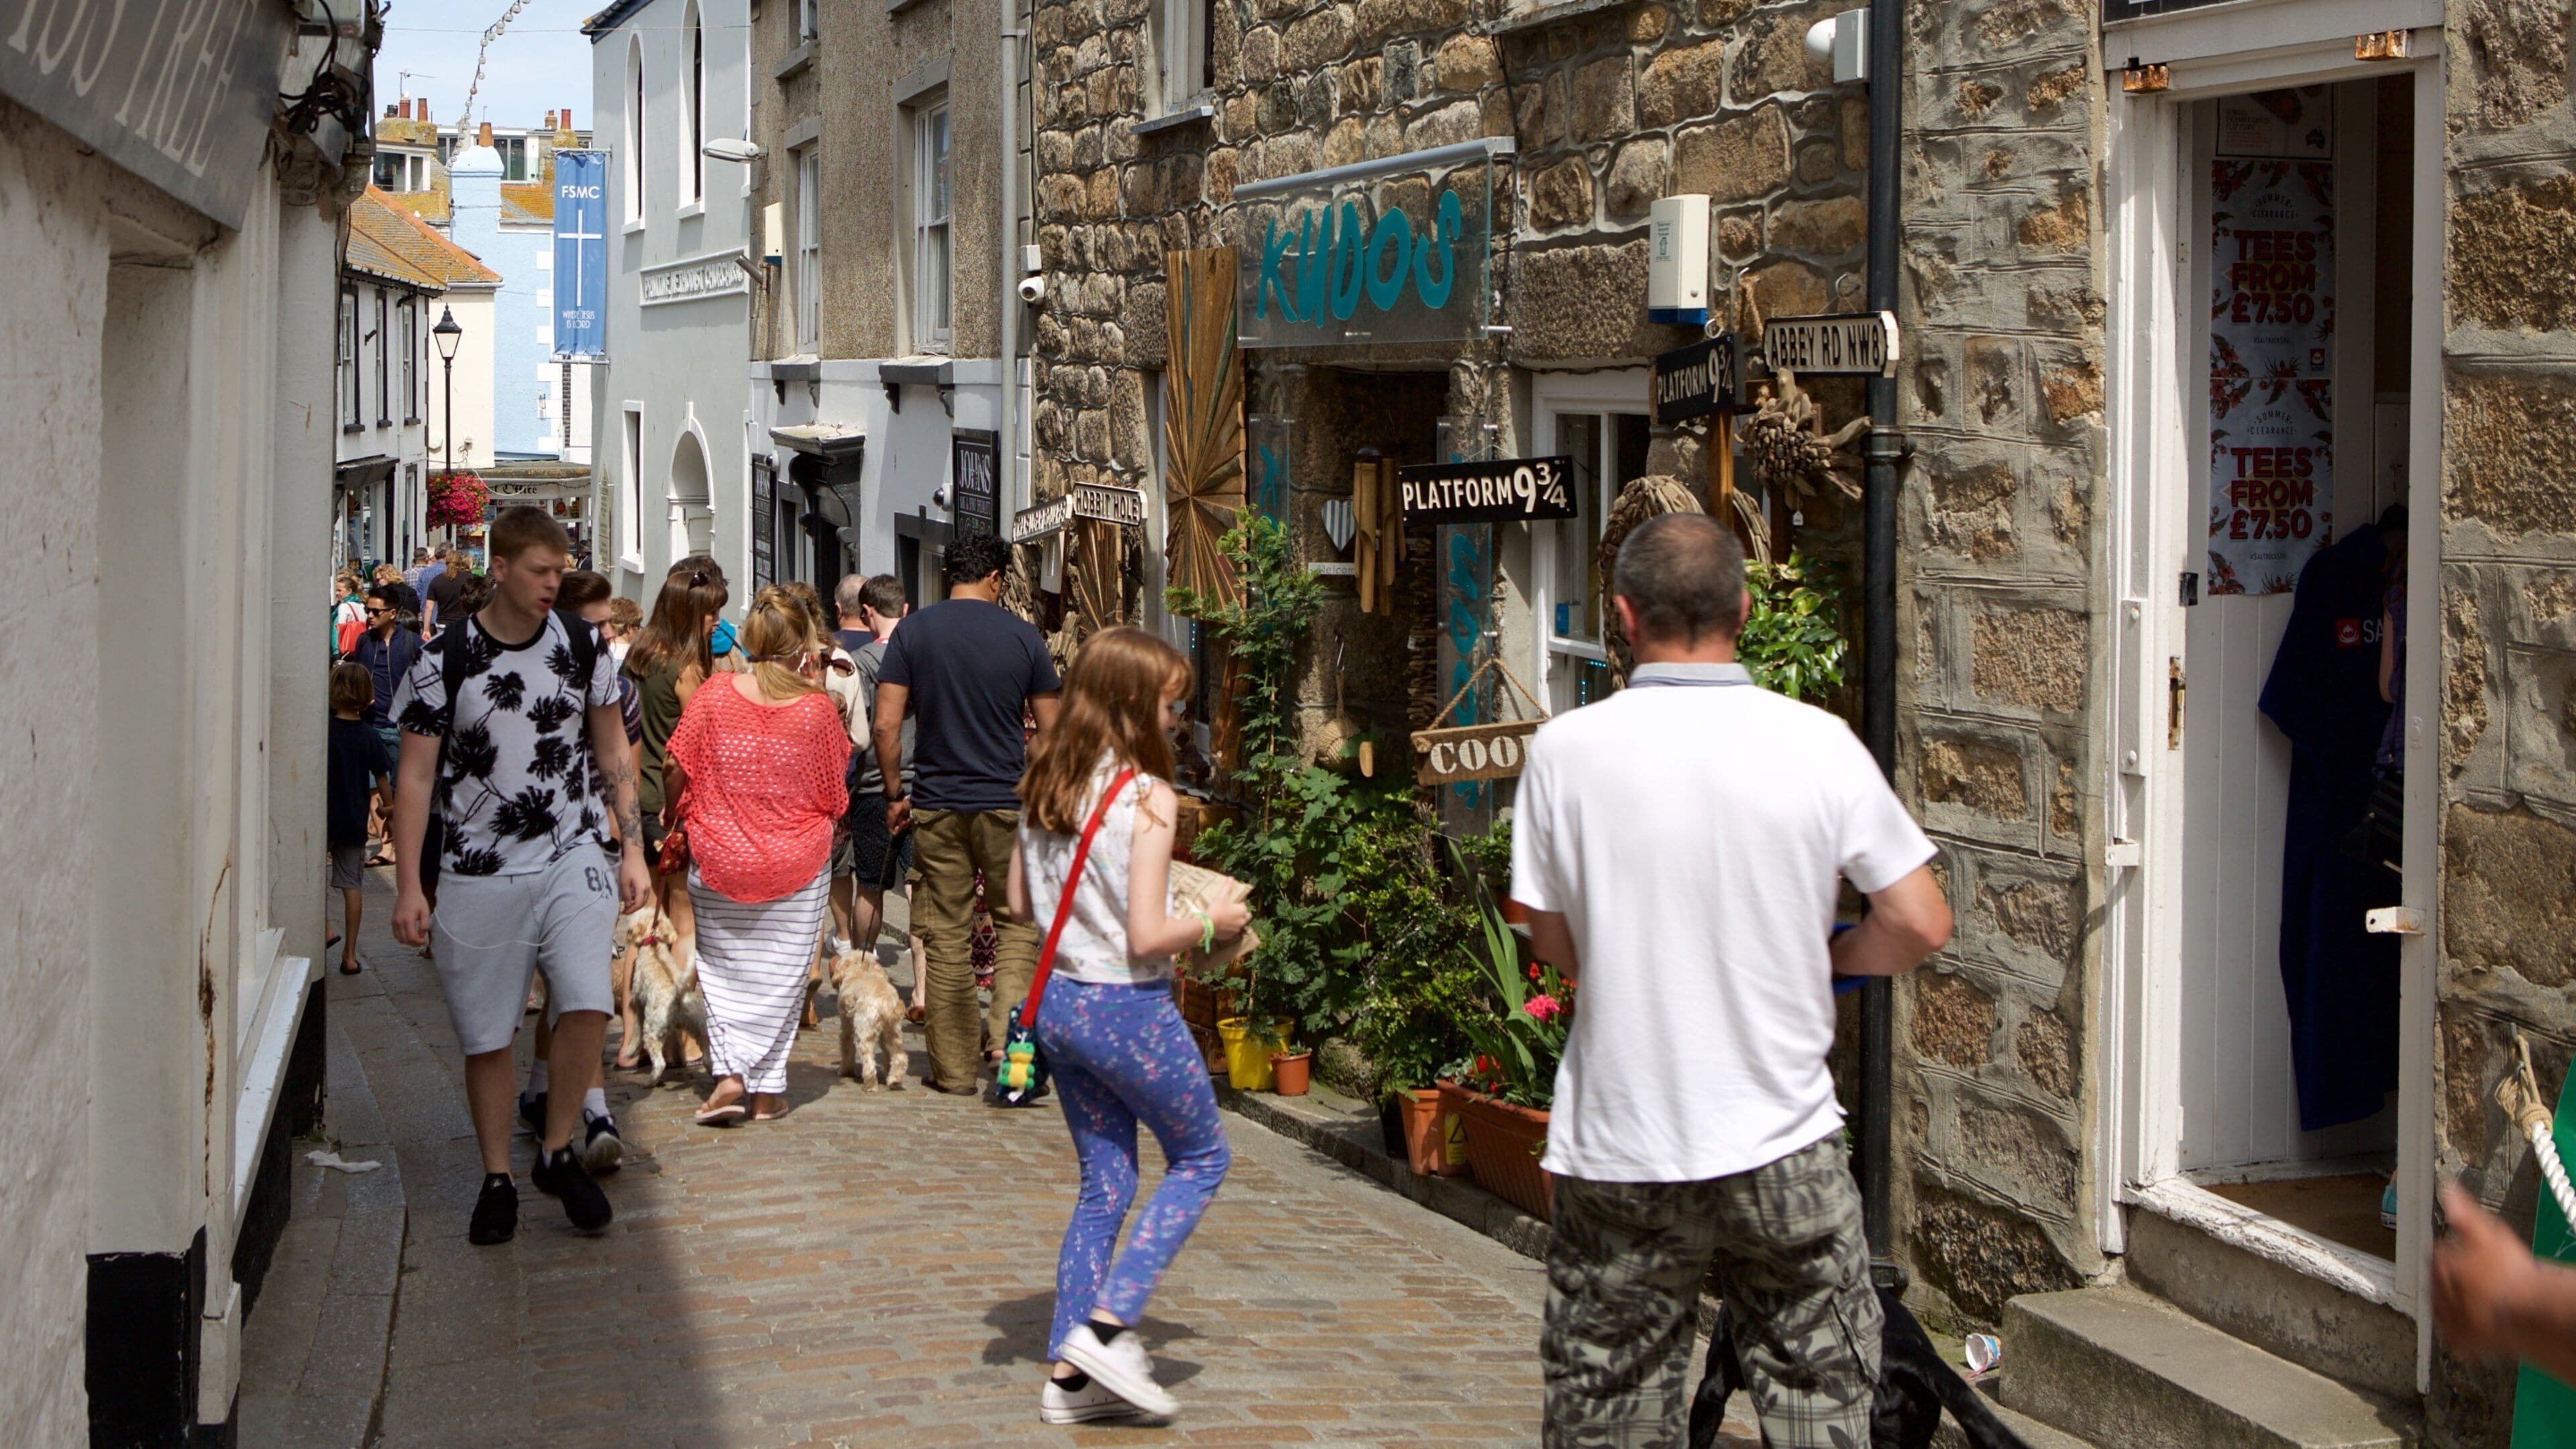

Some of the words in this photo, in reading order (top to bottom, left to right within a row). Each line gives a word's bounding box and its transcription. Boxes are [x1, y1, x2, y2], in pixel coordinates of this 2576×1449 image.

[561, 185, 600, 199] FSMC
[2257, 193, 2292, 207] SUMMER
[2252, 209, 2295, 219] CLEARANCE
[1256, 189, 1462, 328] KUDOS
[2233, 229, 2317, 262] TEES
[2232, 263, 2316, 291] FROM
[562, 310, 580, 320] WHERE
[581, 310, 596, 320] JESUS
[2231, 292, 2315, 324] £7.50
[566, 319, 572, 329] IS
[573, 319, 591, 329] LORD
[1770, 326, 1815, 367] ABBEY
[1821, 325, 1841, 366] RD
[1847, 323, 1880, 367] NW8
[1657, 362, 1708, 405] PLATFORM
[2250, 427, 2294, 435] CLEARANCE
[2257, 409, 2292, 423] SUMMER
[959, 449, 991, 494] JOHNS
[2231, 447, 2314, 478] TEES
[1075, 488, 1112, 517] HOBBIT
[1114, 494, 1140, 521] HOLE
[1402, 476, 1513, 511] PLATFORM
[2231, 479, 2313, 508] FROM
[2229, 508, 2312, 541] £7.50
